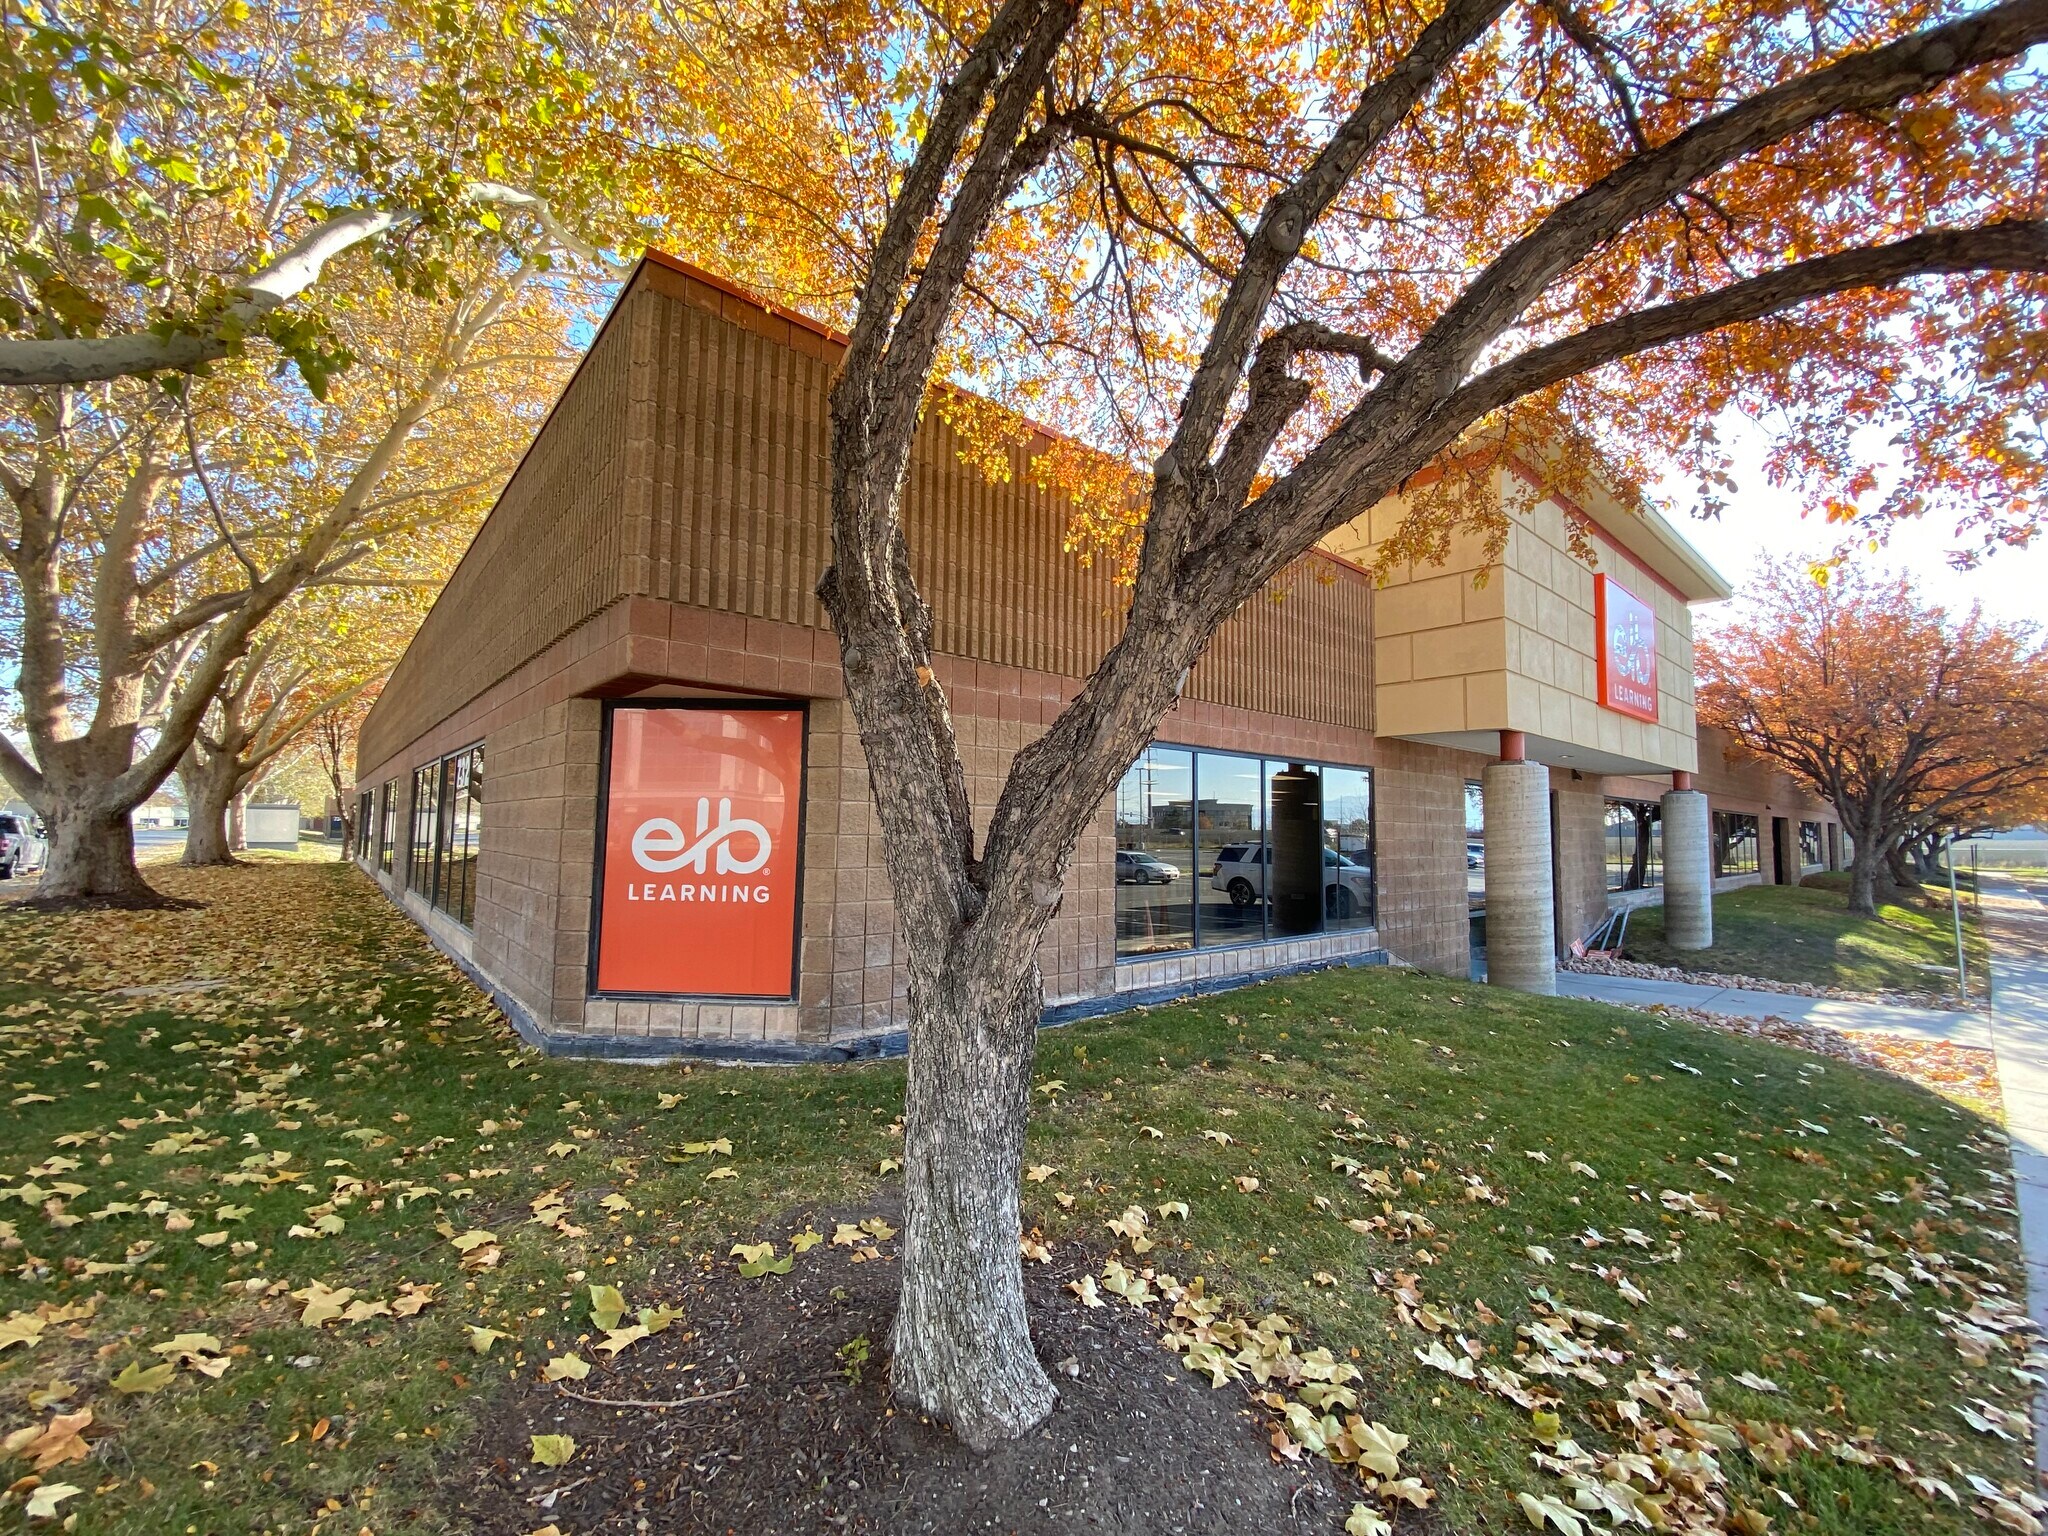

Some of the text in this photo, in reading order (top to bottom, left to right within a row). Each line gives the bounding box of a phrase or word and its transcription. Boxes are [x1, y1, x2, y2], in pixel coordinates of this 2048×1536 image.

[1614, 683, 1653, 711] LEARNING
[631, 797, 772, 875] elb
[628, 883, 770, 903] LEARNING
